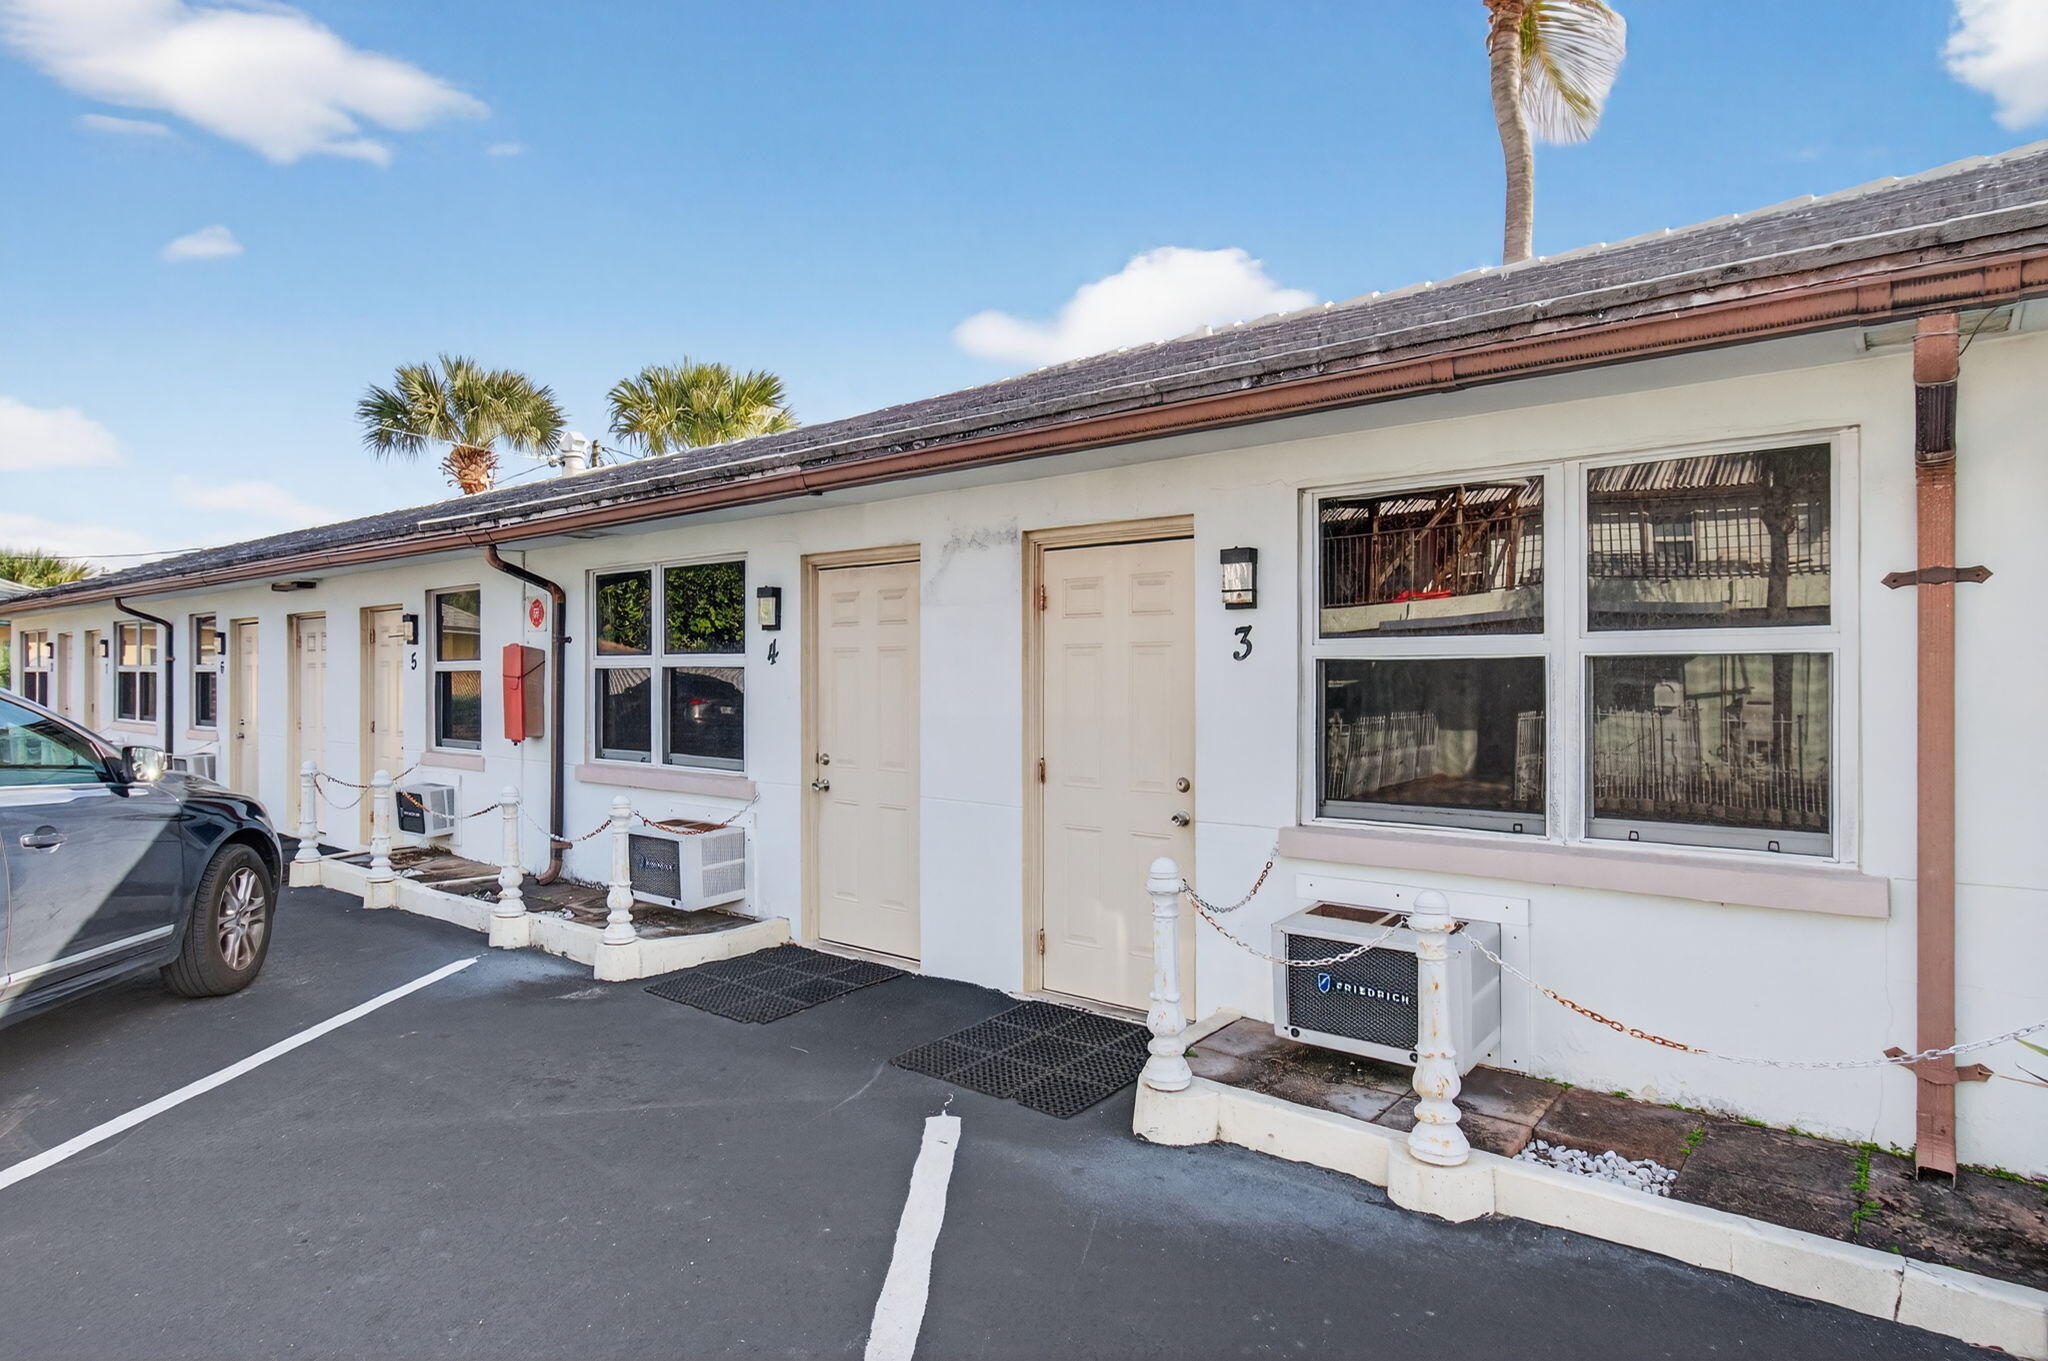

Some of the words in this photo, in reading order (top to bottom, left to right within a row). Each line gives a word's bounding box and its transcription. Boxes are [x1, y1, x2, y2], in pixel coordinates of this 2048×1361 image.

[767, 638, 779, 665] 4
[1233, 625, 1253, 661] 3
[411, 651, 417, 670] 5
[1336, 982, 1409, 1005] FRIEDRICH
